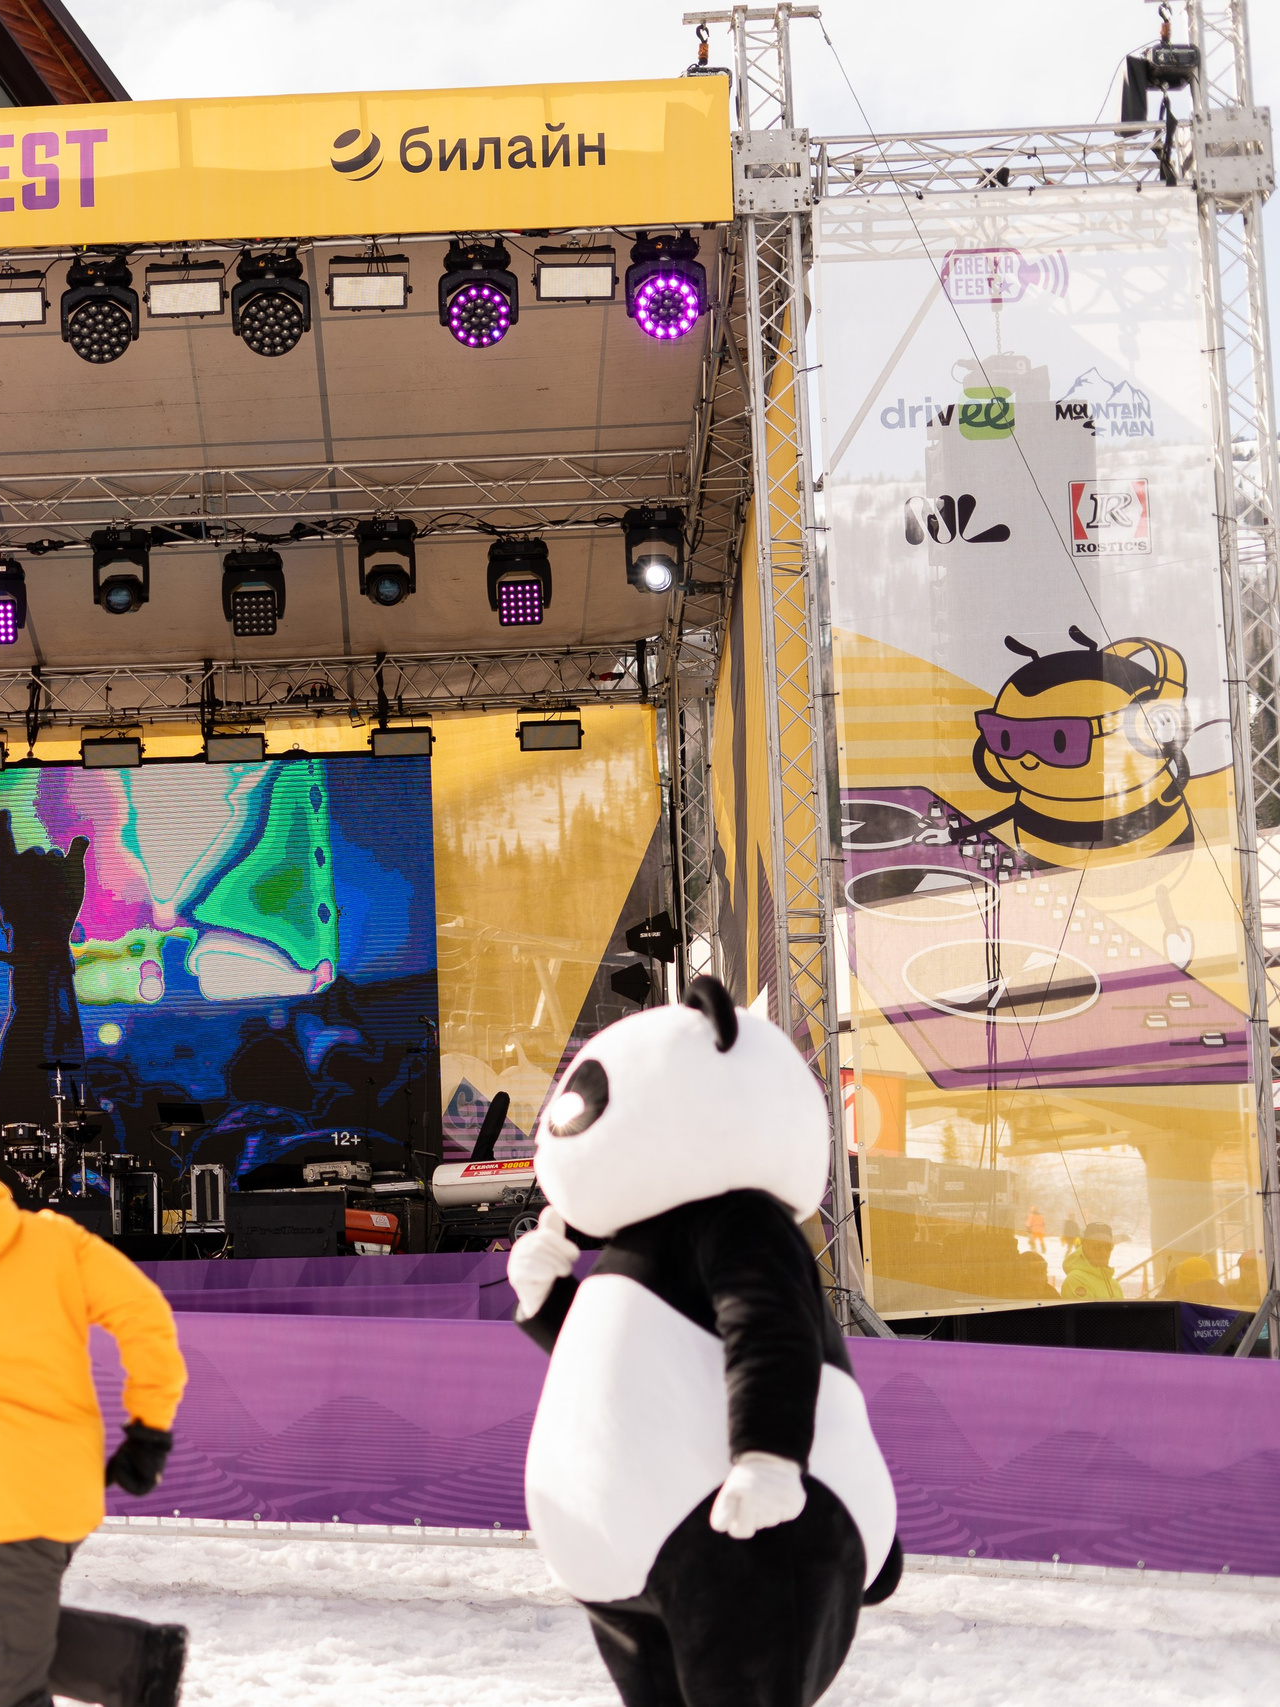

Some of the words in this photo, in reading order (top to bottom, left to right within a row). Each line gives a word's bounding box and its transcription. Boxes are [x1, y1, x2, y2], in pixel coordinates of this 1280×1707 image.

[400, 122, 607, 174] билайн
[953, 256, 1014, 275] GRELKA
[955, 278, 994, 296] FEST
[880, 396, 1016, 430] drivee
[1055, 403, 1151, 420] MOUNTAIN
[1111, 420, 1154, 437] MAN
[1075, 541, 1148, 553] ROSTIC'S
[331, 1131, 361, 1145] 12+
[502, 1161, 530, 1169] 30000
